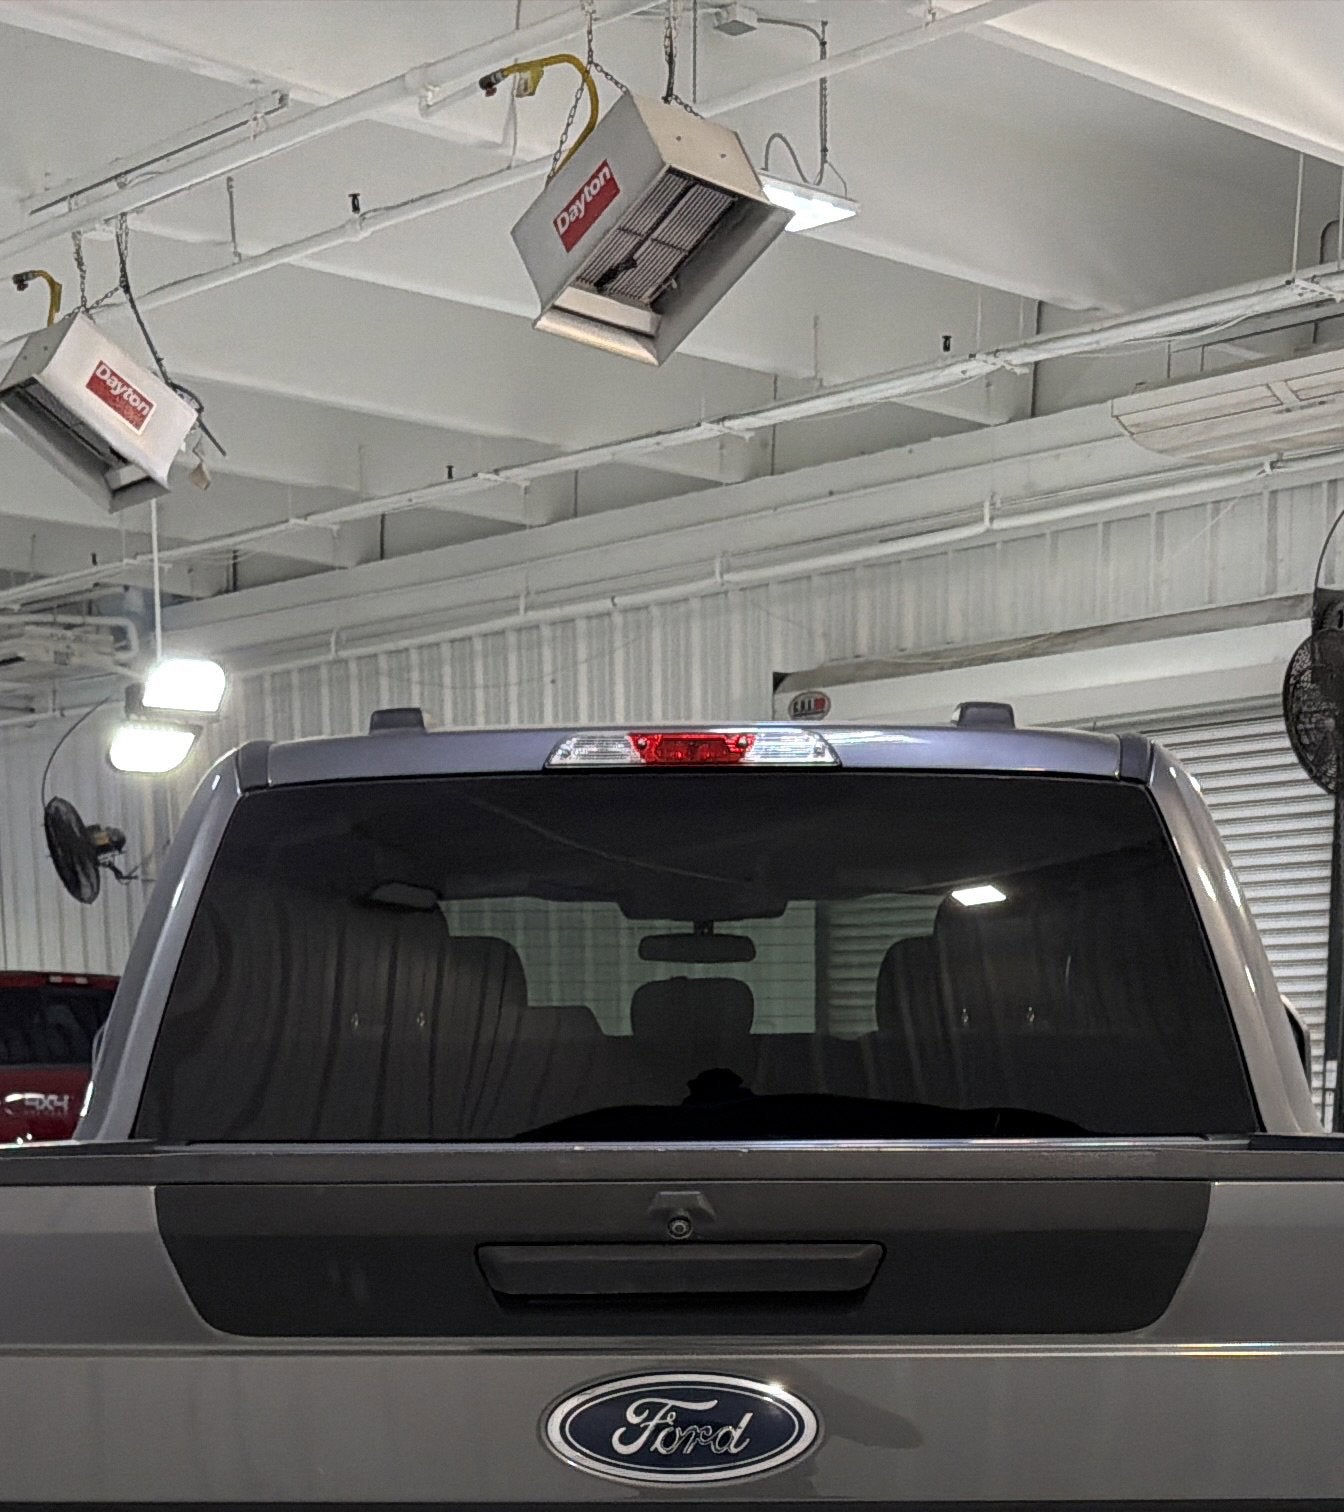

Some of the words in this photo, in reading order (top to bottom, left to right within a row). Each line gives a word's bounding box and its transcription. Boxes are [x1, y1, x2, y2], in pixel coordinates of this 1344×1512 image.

[557, 165, 611, 235] Dayton
[96, 364, 150, 416] Dayton
[612, 1397, 754, 1455] Ford
